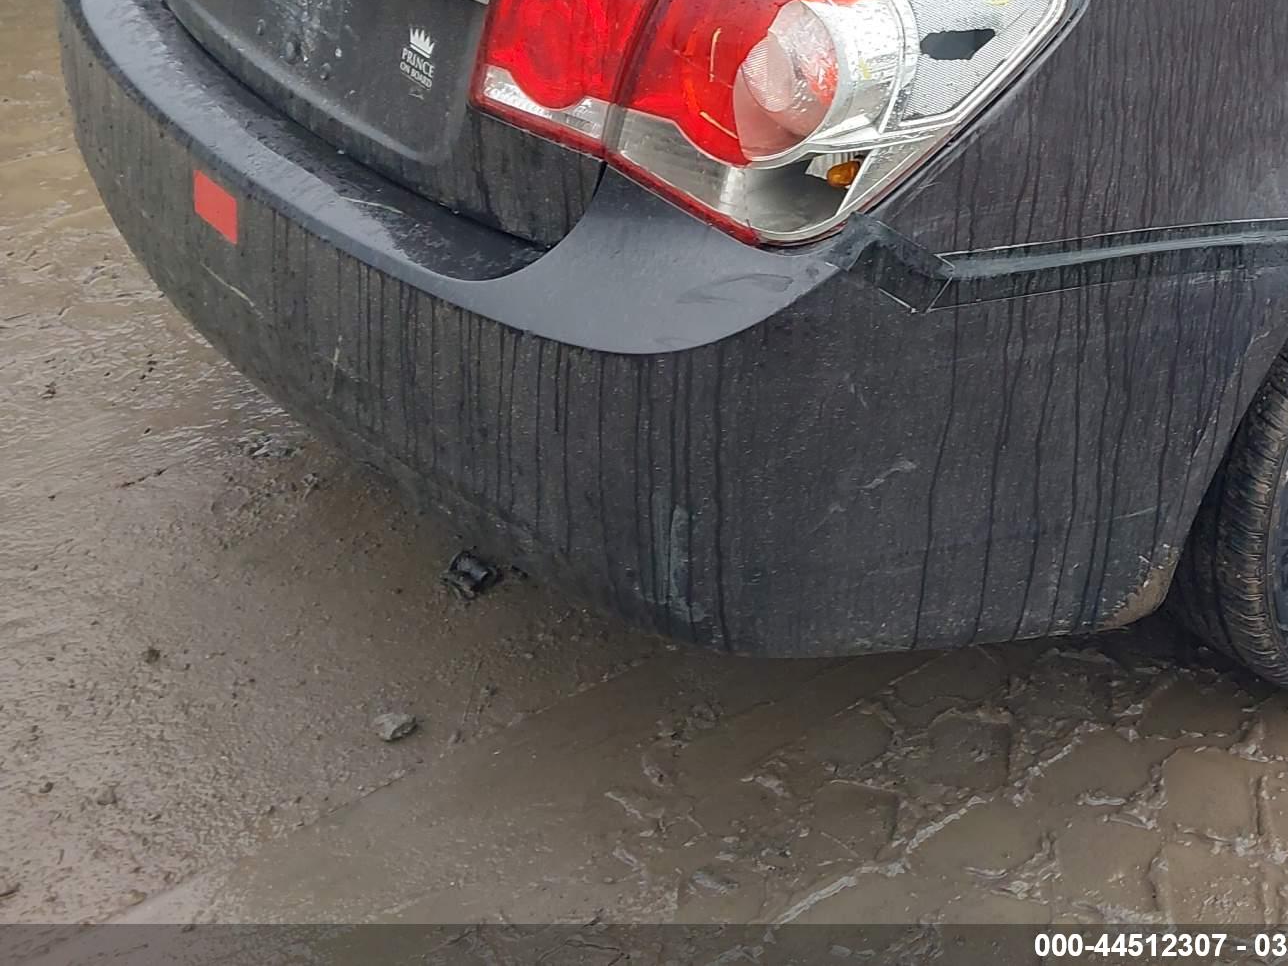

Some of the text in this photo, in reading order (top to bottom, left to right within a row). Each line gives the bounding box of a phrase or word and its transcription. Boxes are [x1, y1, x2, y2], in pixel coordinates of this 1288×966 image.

[399, 61, 433, 88] ON BOARD
[401, 47, 435, 78] PRINCE
